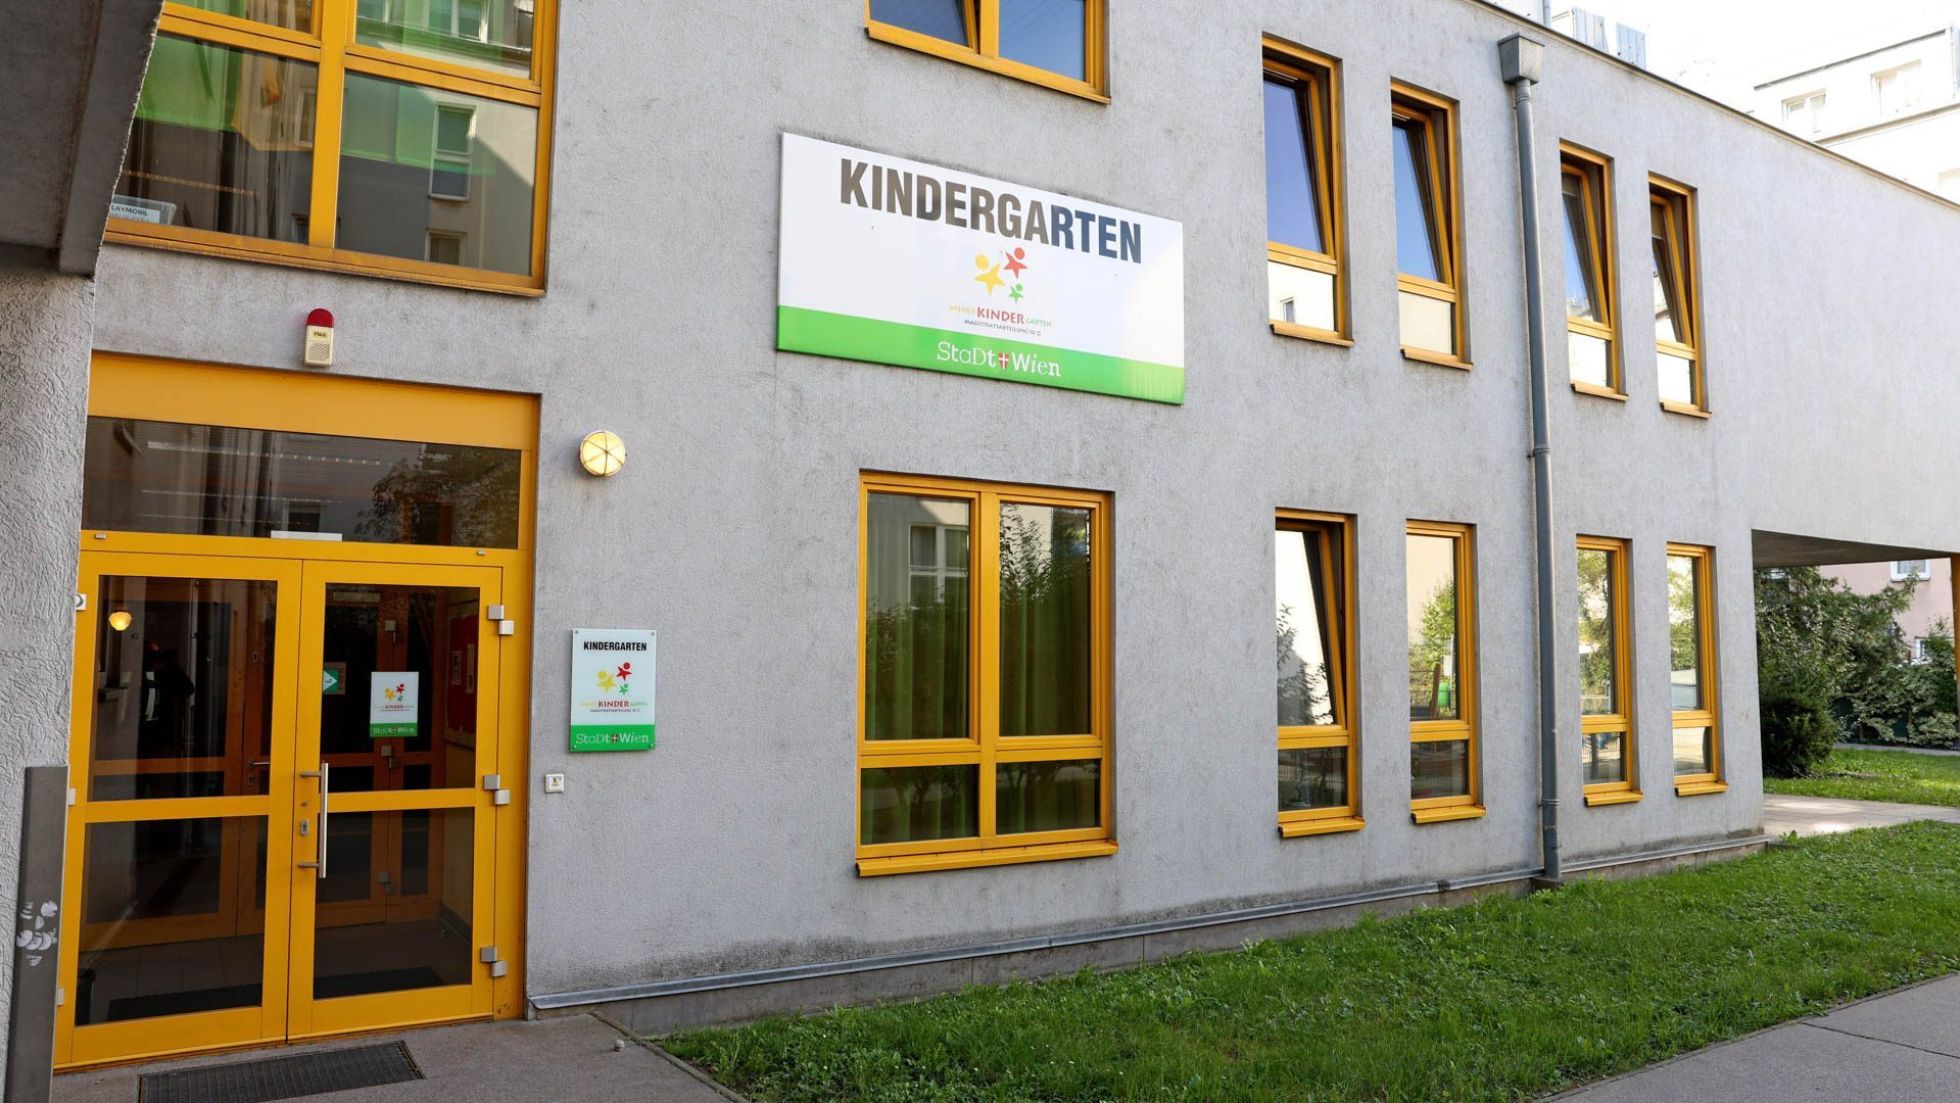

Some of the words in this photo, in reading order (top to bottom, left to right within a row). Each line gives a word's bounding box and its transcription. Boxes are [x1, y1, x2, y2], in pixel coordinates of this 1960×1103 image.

[111, 205, 148, 216] LAYMOBIL
[840, 158, 1142, 264] KINDERGARTEN
[1012, 352, 1061, 377] Wien
[583, 641, 647, 651] KINDERGARTEN
[598, 700, 630, 708] KINDER
[620, 732, 649, 744] Wien
